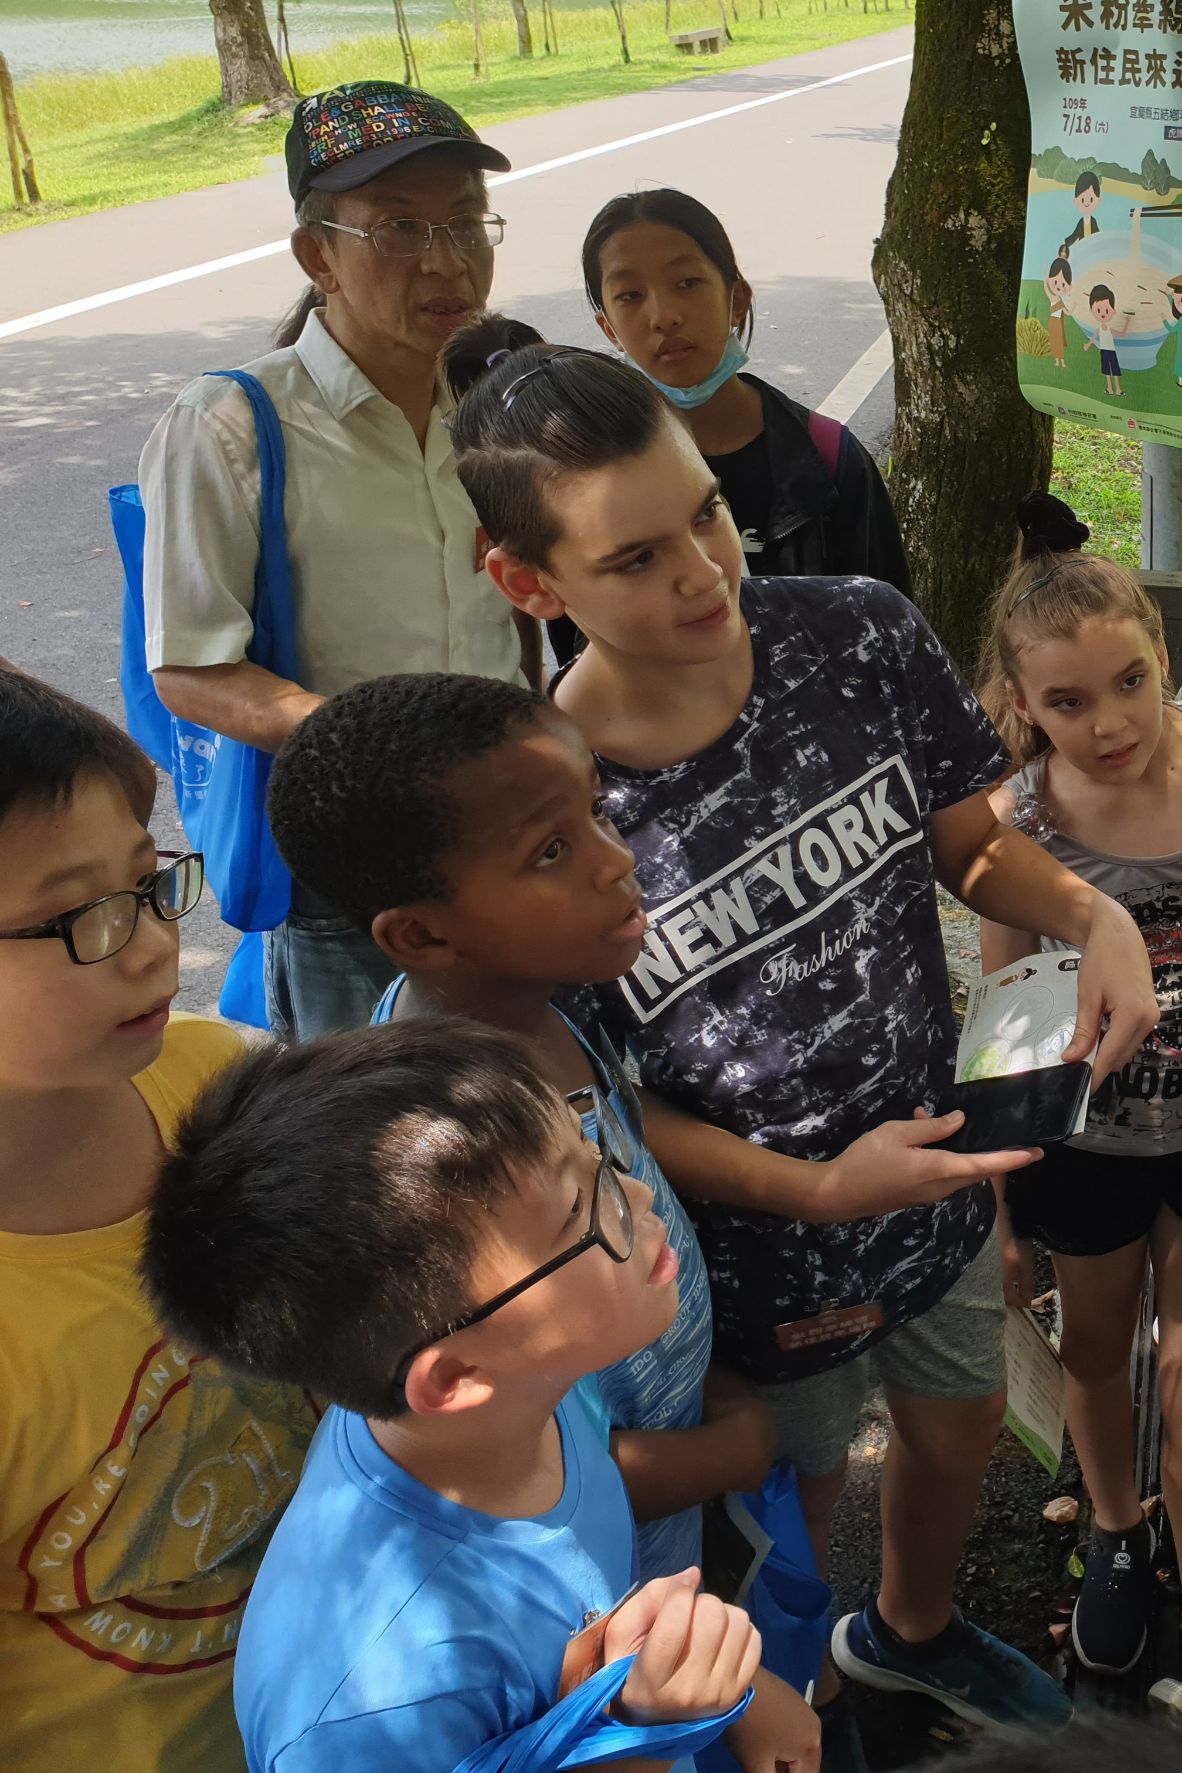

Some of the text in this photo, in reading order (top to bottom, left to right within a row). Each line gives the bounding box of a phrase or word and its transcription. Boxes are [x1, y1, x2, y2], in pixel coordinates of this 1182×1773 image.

[352, 102, 405, 120] SHALL
[1062, 97, 1087, 110] 109年
[1062, 113, 1092, 136] 7/18
[633, 776, 911, 1000] NEW YORK
[759, 916, 872, 997] Fashion
